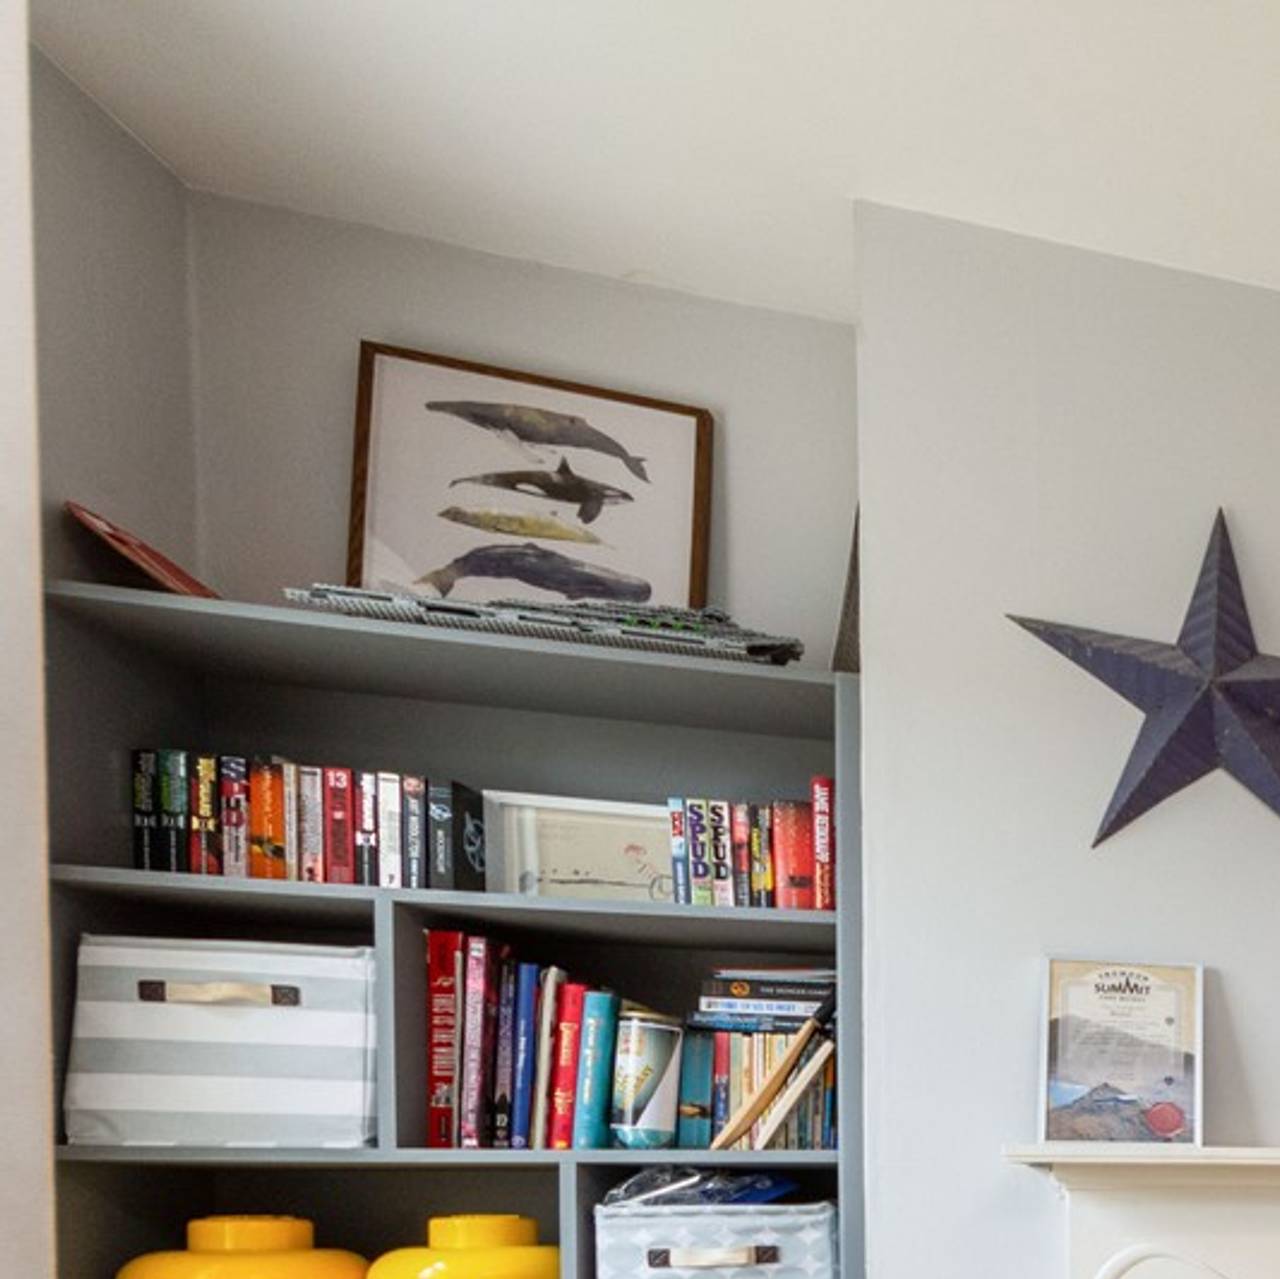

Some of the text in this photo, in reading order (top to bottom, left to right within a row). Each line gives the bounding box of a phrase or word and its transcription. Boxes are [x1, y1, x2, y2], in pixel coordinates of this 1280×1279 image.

[688, 803, 711, 880] SPUD
[709, 804, 729, 880] SPUD
[1094, 976, 1151, 995] SUMMIT
